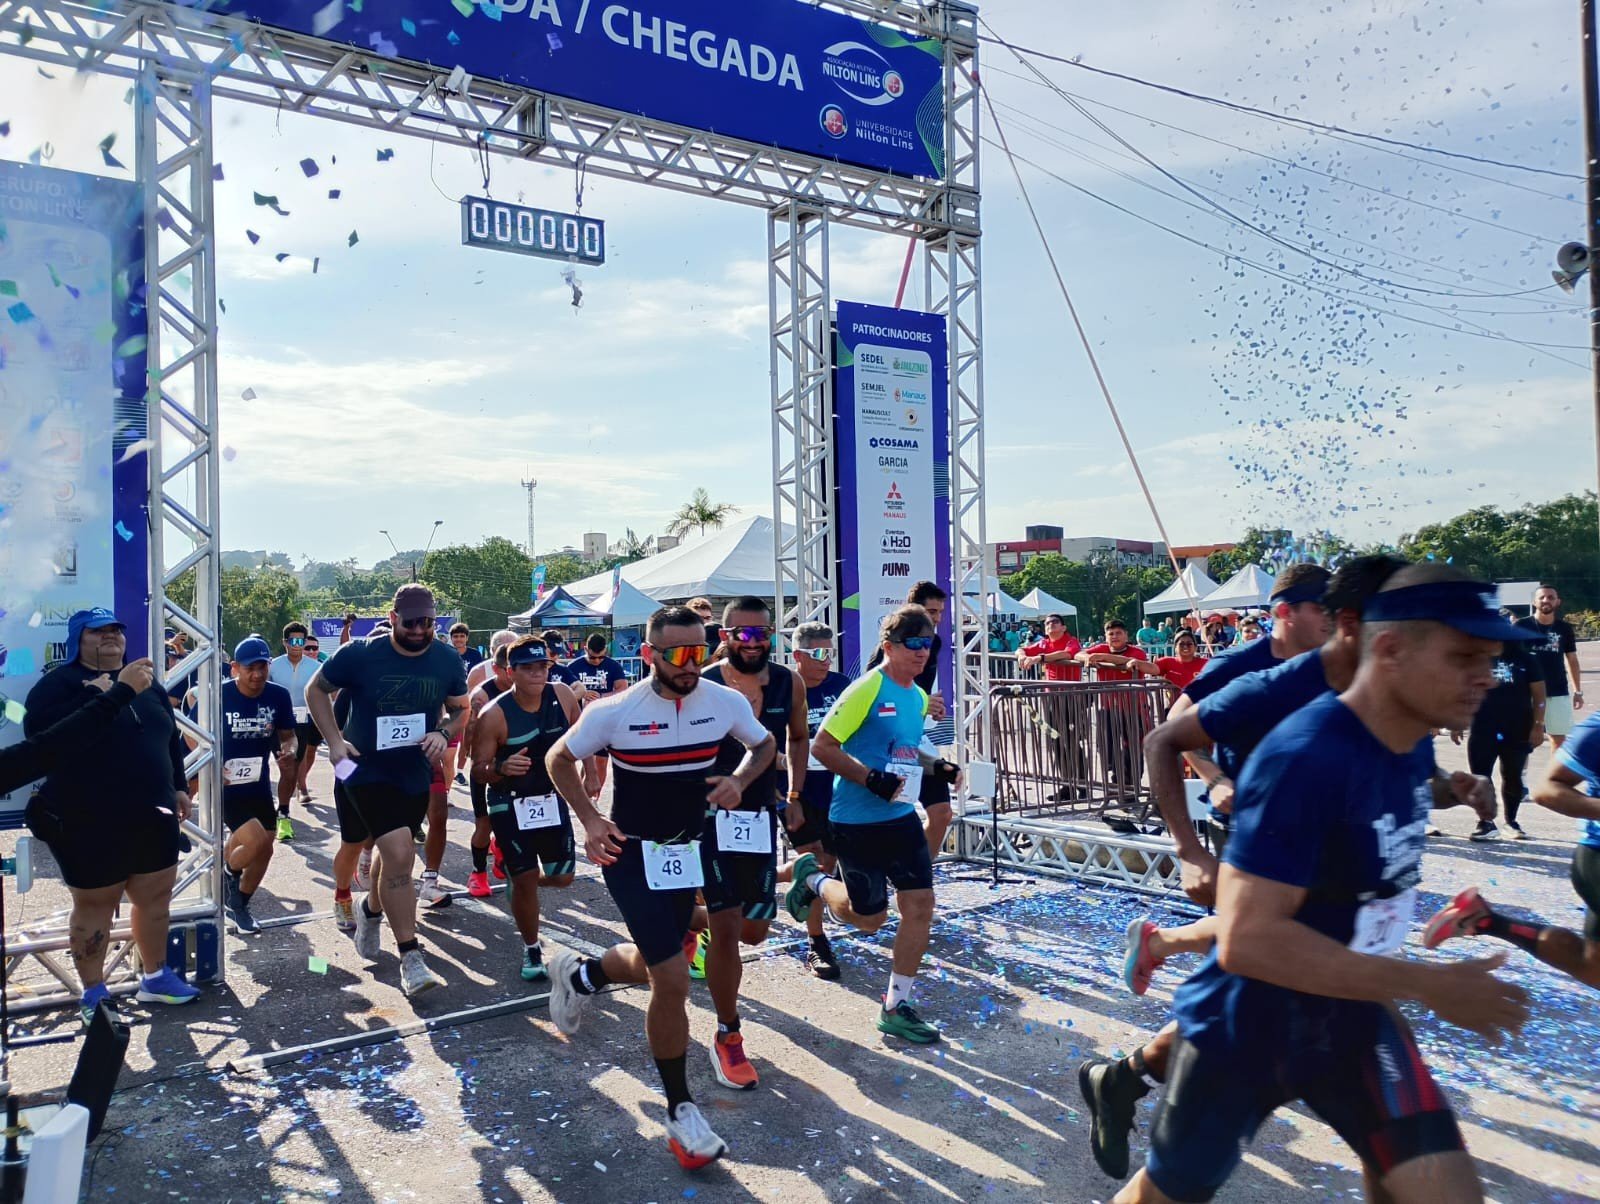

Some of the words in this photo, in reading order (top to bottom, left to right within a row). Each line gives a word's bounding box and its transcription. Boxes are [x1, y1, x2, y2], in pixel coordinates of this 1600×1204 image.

[601, 4, 805, 91] CHEGADA
[822, 62, 858, 83] NILTON
[860, 73, 881, 88] LINS
[855, 119, 913, 140] UNIVERSIDADE
[855, 127, 889, 145] Nilton
[891, 138, 914, 150] Lins
[852, 322, 932, 343] PATROCINADORES
[860, 352, 885, 365] SEDEL
[861, 382, 886, 392] SEMJEL
[878, 437, 919, 449] COSAMA
[878, 455, 909, 468] GARCIA
[881, 562, 911, 577] PUMP
[391, 727, 410, 740] 23
[235, 767, 252, 778] 42
[528, 807, 545, 819] 24
[733, 826, 751, 841] 21
[661, 859, 683, 876] 48
